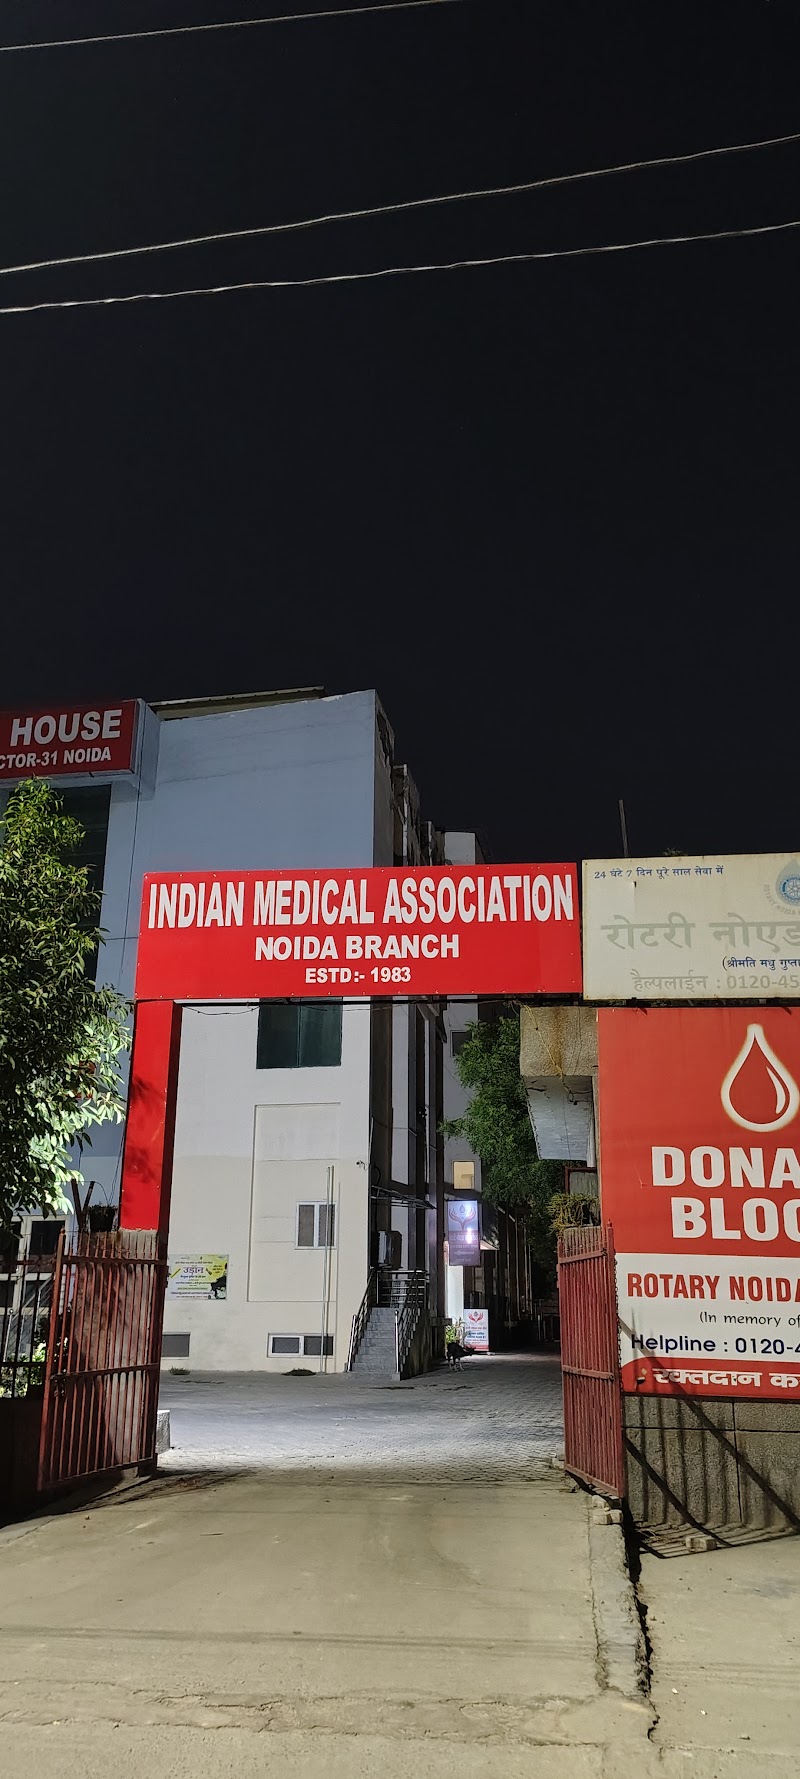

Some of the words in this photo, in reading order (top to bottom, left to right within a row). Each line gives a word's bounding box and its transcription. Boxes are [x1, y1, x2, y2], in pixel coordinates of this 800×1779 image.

[10, 709, 122, 747] HOUSE
[63, 747, 111, 764] NOIDA
[594, 871, 606, 879] 24
[609, 868, 623, 878] घंटे
[636, 867, 653, 877] दिन
[656, 868, 670, 879] पूरे
[672, 868, 691, 876] साल
[694, 866, 712, 876] सेवा
[715, 865, 724, 875] में
[148, 882, 245, 929] INDIAN
[253, 879, 375, 926] MEDICAL
[382, 874, 574, 924] ASSOCIATION
[601, 912, 696, 949] रोटरी
[255, 936, 339, 961] NOIDA
[346, 934, 459, 959] BRANCH
[370, 966, 411, 983] 1983
[760, 959, 776, 971] मधु
[630, 968, 708, 993] हैल्पलाईन
[726, 975, 800, 989] 0120-45
[651, 1146, 800, 1189] DONA
[627, 1273, 720, 1300] ROTARY
[724, 1315, 781, 1328] memory
[631, 1334, 716, 1353] Helpline
[652, 1368, 762, 1387] रक्तदान
